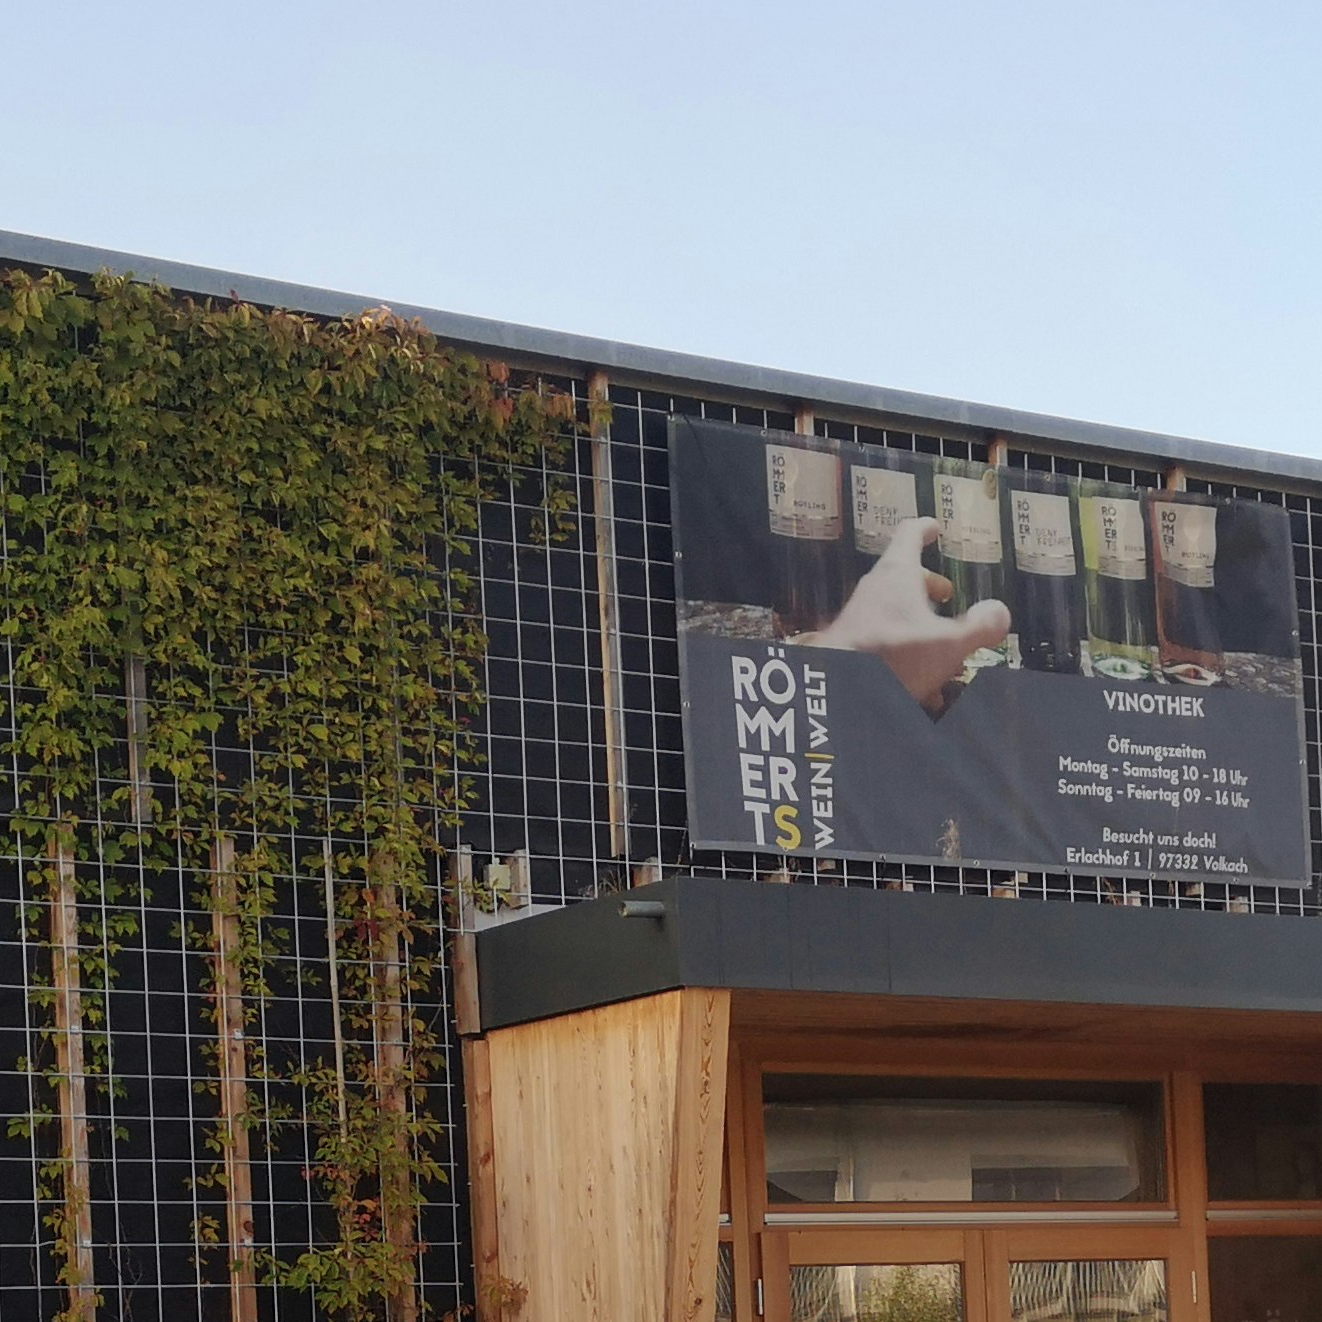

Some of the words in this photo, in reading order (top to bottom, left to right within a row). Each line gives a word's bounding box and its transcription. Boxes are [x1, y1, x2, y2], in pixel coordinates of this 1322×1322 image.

[732, 646, 796, 704] RÖ
[803, 663, 829, 749] WELT
[1102, 689, 1205, 718] VINOTHEK
[735, 703, 795, 754] MM
[1107, 734, 1207, 762] Öffnungszeiten
[739, 752, 799, 801] ER
[1058, 756, 1109, 780] Montag
[1122, 761, 1179, 785] Samstag
[1182, 765, 1199, 781] 10
[1212, 768, 1227, 784] 18
[1229, 769, 1249, 787] Uhr
[810, 762, 835, 850] WEIN
[1057, 778, 1113, 803] Sonntag
[1127, 784, 1180, 808] Feiertag
[1183, 787, 1201, 804] 09
[1215, 790, 1229, 806] 16
[1231, 791, 1251, 809] Uhr
[743, 800, 802, 850] TS
[1102, 827, 1154, 845] Besucht
[1157, 834, 1179, 847] uns
[1182, 831, 1217, 848] doch!
[1066, 847, 1129, 866] Erlachhof
[1134, 851, 1141, 867] 1
[1158, 852, 1199, 870] 97332
[1203, 855, 1248, 873] Volkach
